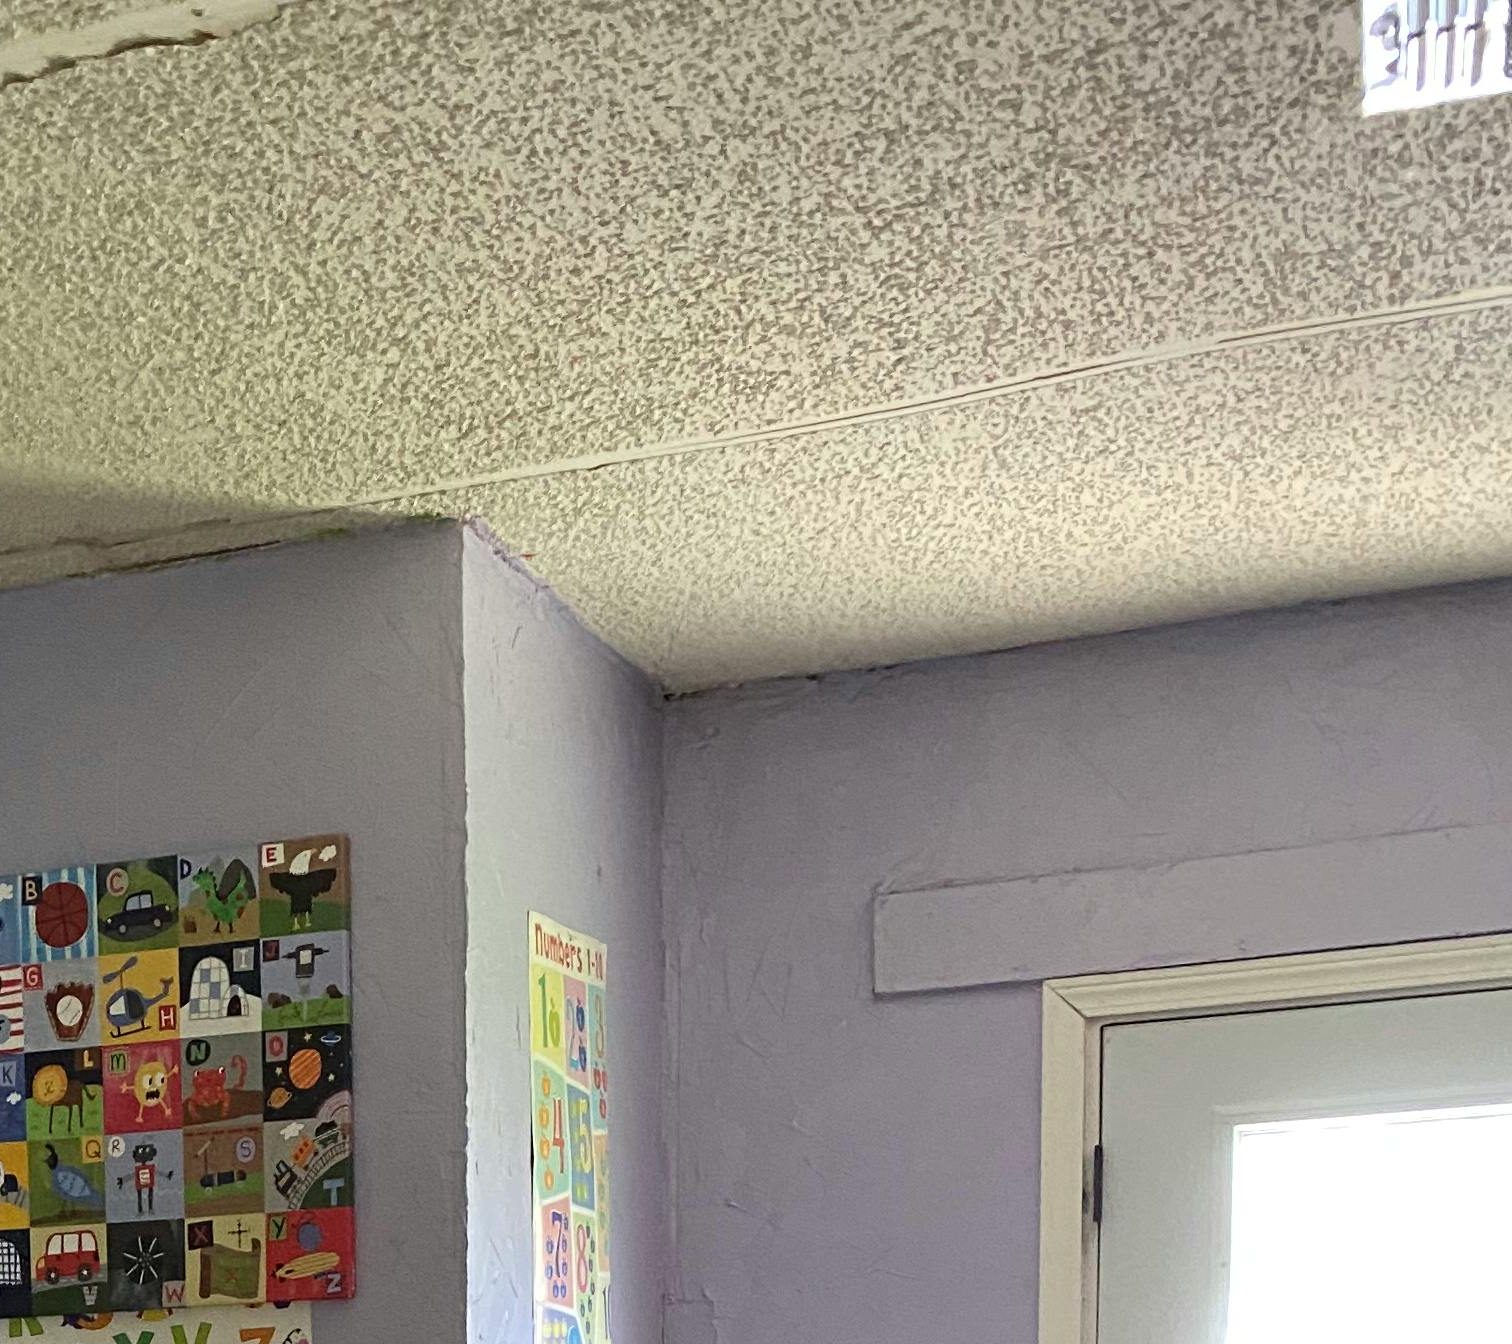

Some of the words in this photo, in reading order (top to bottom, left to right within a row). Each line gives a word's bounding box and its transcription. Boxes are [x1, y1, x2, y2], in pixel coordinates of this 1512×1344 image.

[266, 847, 277, 863] E
[180, 859, 192, 879] D
[25, 881, 38, 900] B
[110, 871, 124, 894] C
[26, 967, 38, 986] G
[161, 1009, 174, 1028] H
[538, 973, 548, 1048] 1
[566, 996, 579, 1071] 2
[190, 1043, 206, 1062] N
[269, 1035, 284, 1057] O
[83, 1050, 94, 1068] L
[2, 1066, 13, 1084] K
[111, 1139, 121, 1151] R
[553, 1097, 564, 1174] 4
[86, 1139, 101, 1159] Q
[240, 1141, 252, 1158] S
[323, 1178, 344, 1206] T
[551, 1211, 563, 1278] 7
[577, 1224, 588, 1293] 8
[327, 1273, 341, 1293] Z
[166, 1286, 185, 1303] W
